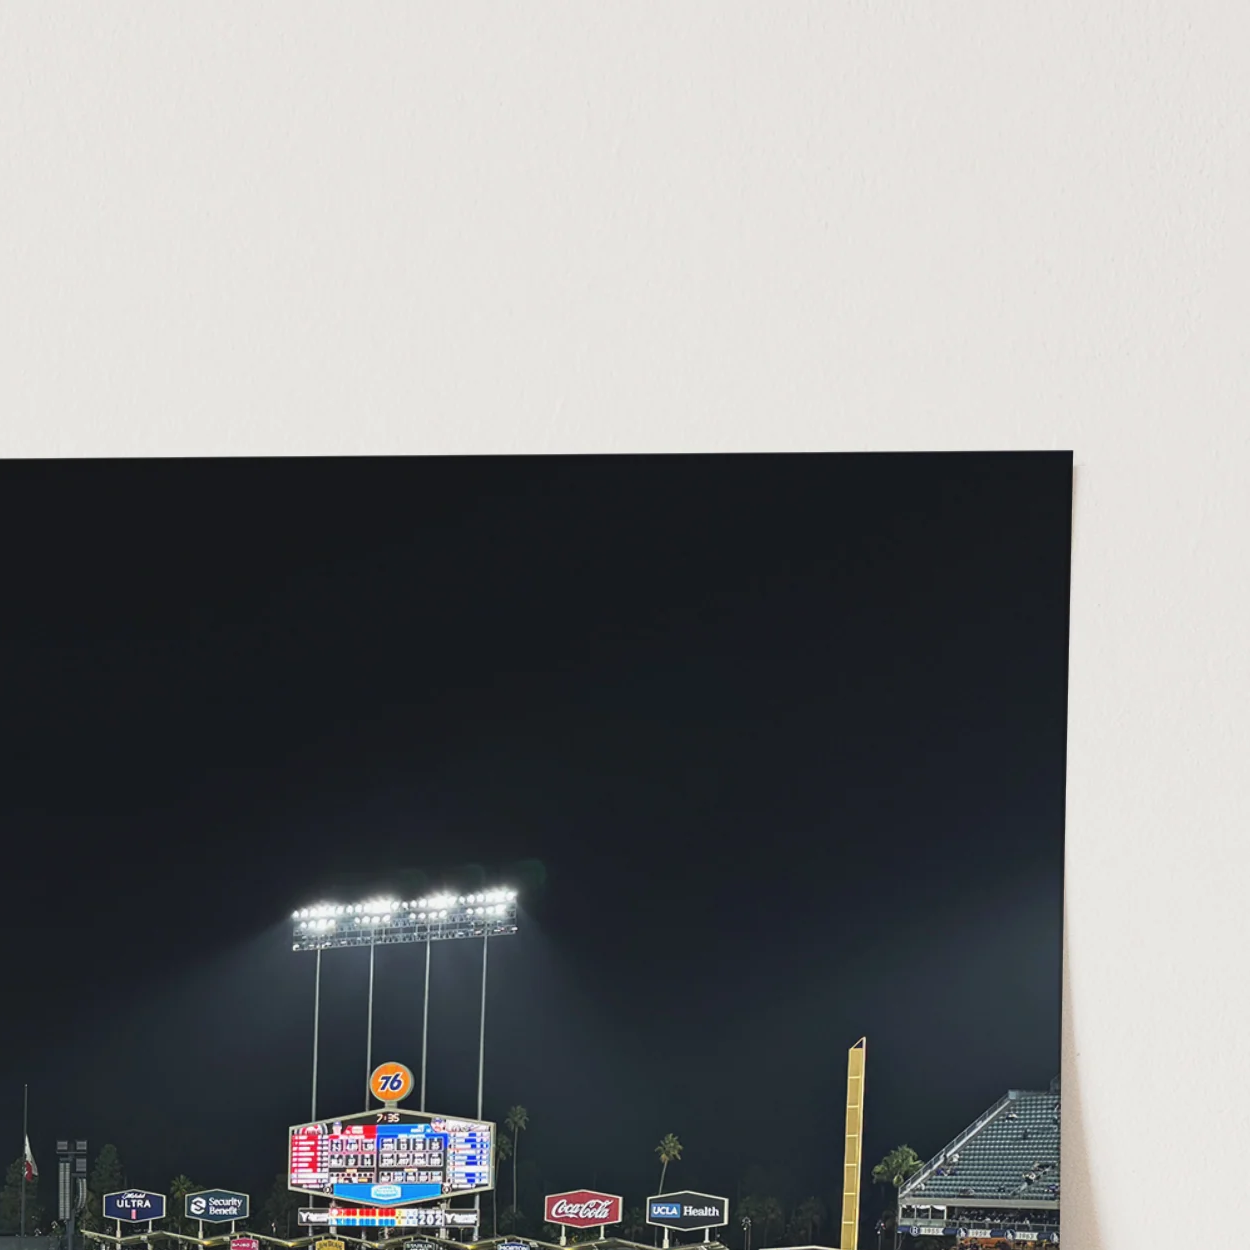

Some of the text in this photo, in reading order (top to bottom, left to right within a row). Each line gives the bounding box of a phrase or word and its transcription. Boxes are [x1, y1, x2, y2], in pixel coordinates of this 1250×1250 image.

[378, 1073, 403, 1091] 76
[376, 1113, 400, 1122] 7:35
[116, 1200, 151, 1208] ULTRA
[208, 1197, 243, 1207] Security
[209, 1206, 238, 1215] Benefit
[551, 1199, 613, 1218] Coca-Cola
[652, 1206, 719, 1217] UCLA Health
